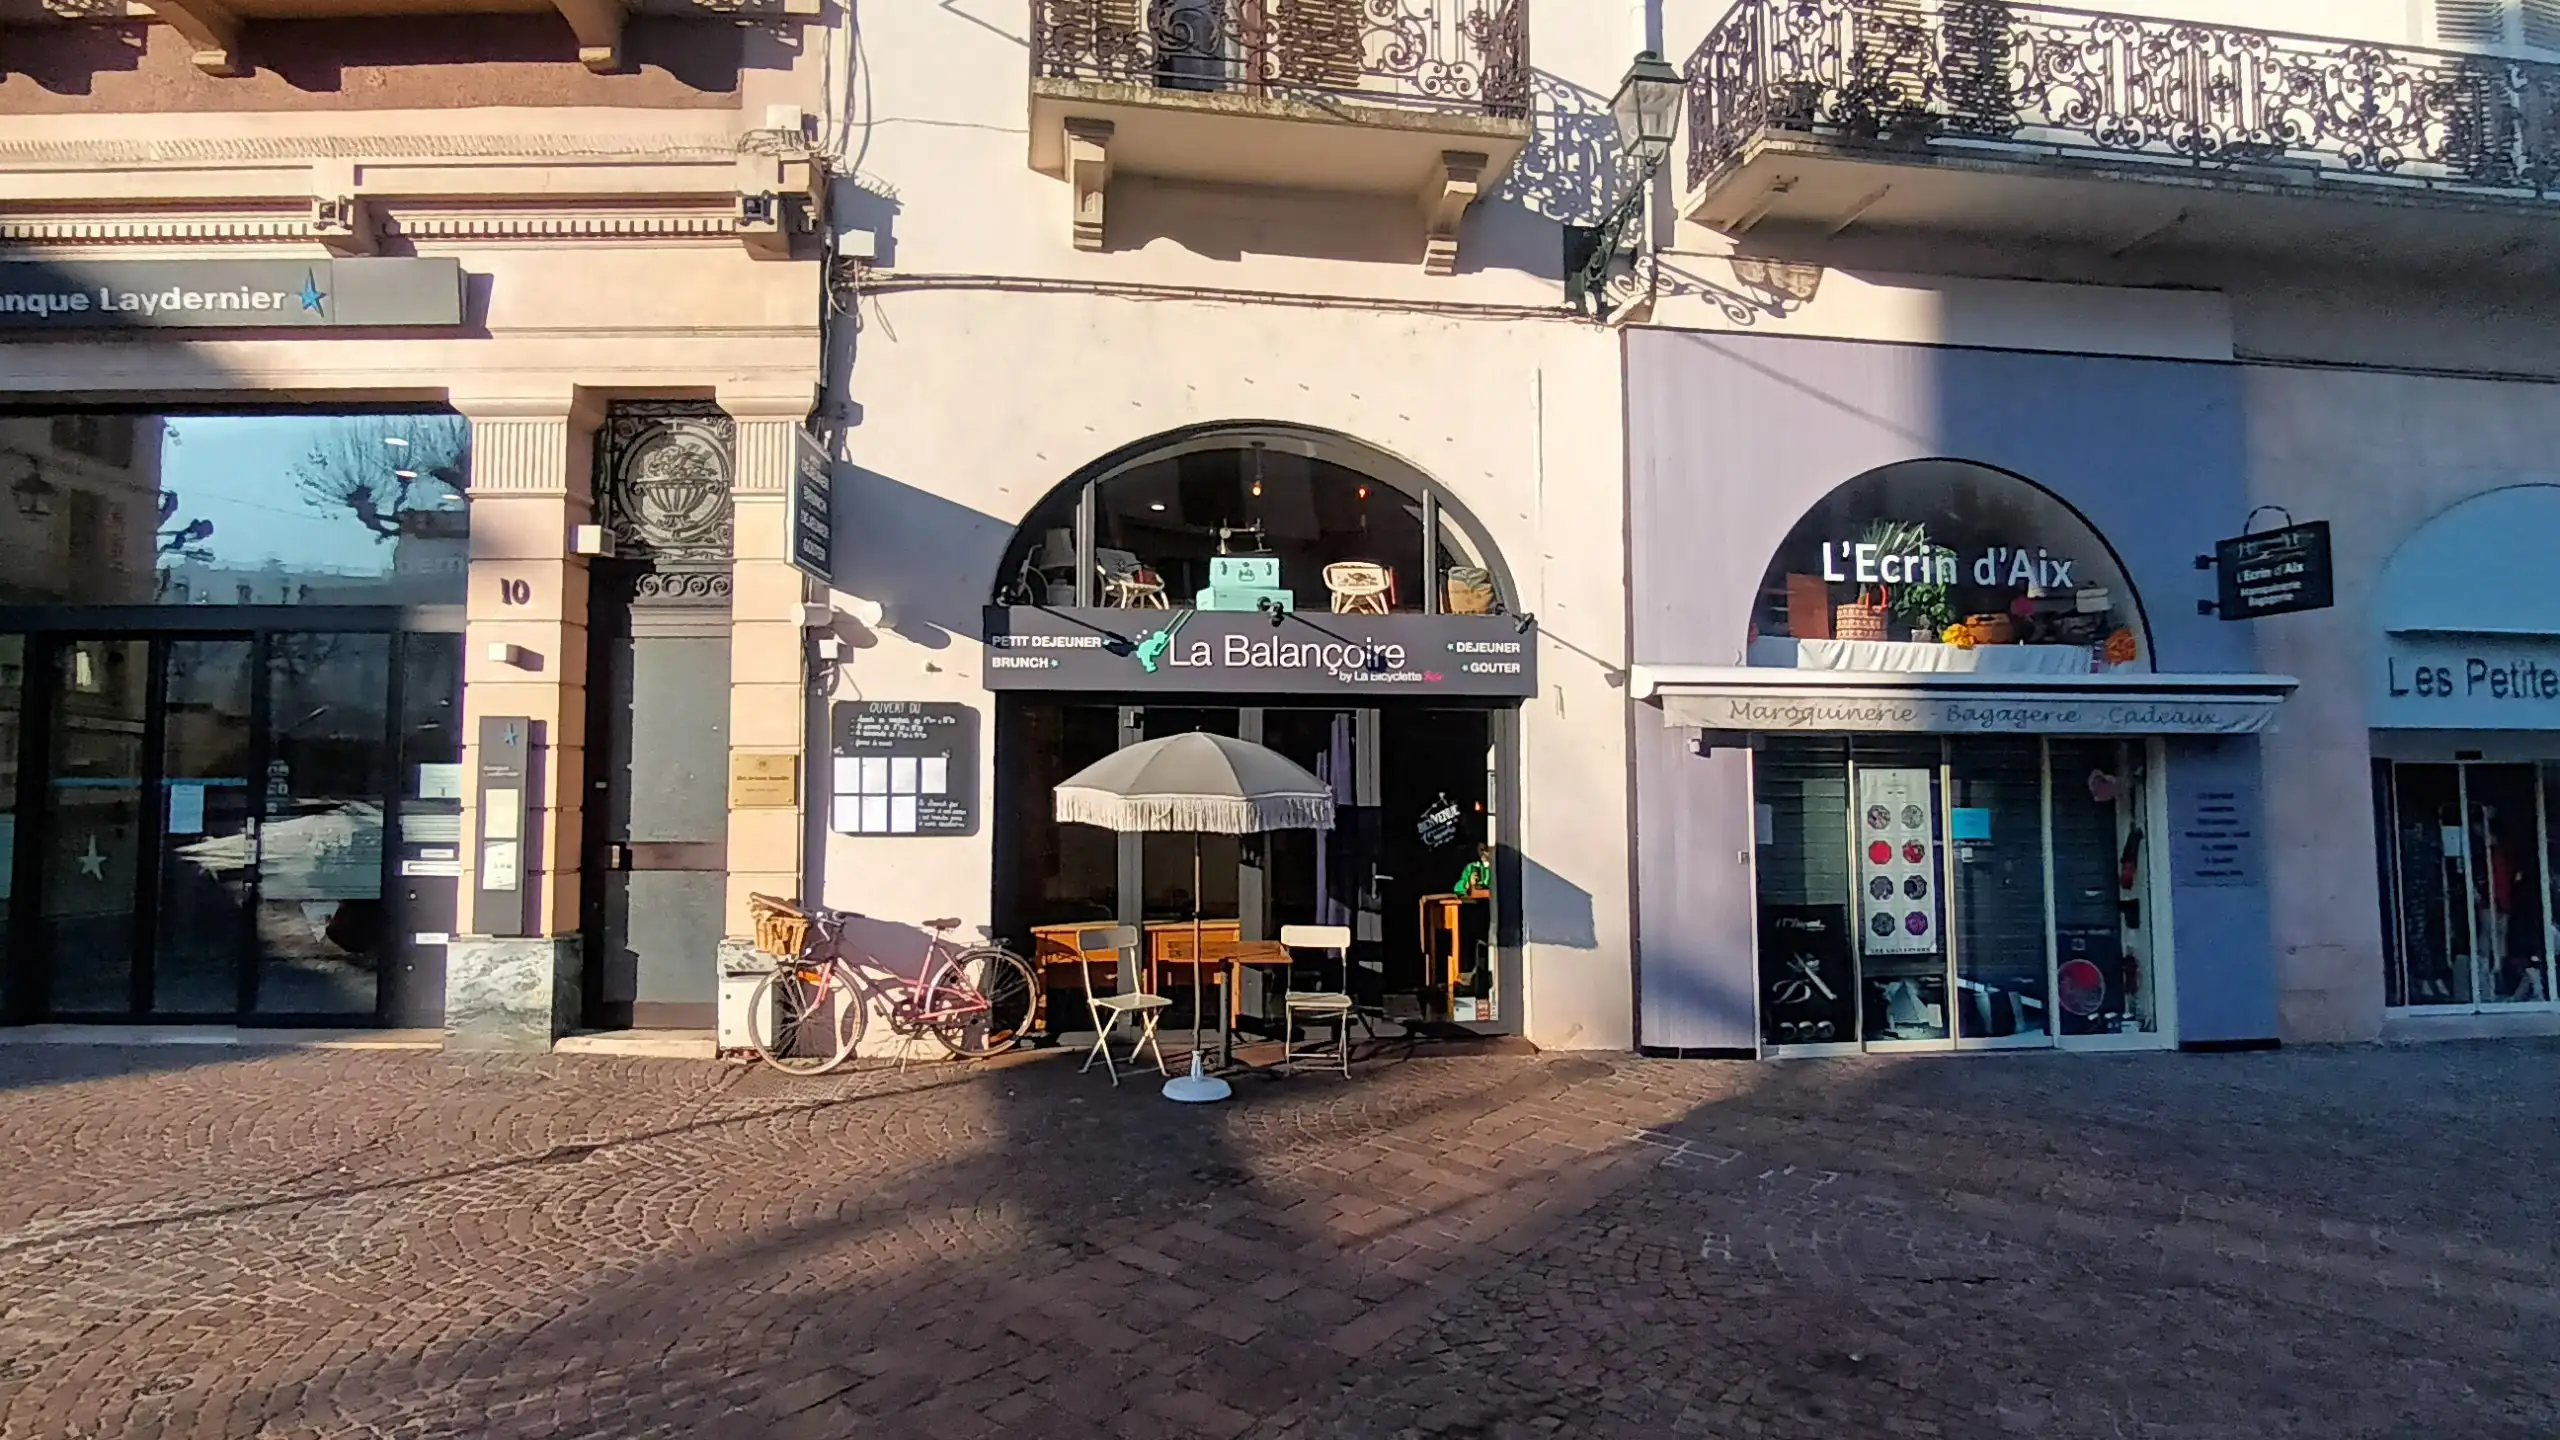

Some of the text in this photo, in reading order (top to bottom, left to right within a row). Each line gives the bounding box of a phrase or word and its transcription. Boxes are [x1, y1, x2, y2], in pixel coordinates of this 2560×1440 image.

[101, 286, 287, 316] Laydernier
[1822, 541, 2073, 587] L'Ecrin d'Aix
[500, 578, 530, 605] 10
[992, 635, 1101, 648] PETIT DEJEUNER
[1169, 633, 1406, 676] La Balançoire
[1456, 642, 1520, 653] DEJEUNER
[992, 656, 1049, 669] BRUNCH
[1470, 662, 1520, 673] GOUTER
[1339, 672, 1353, 682] by
[1354, 671, 1368, 681] La
[2388, 656, 2453, 698] Les
[1730, 700, 2219, 729] Maroquinerie Bagagerie Cadeaux
